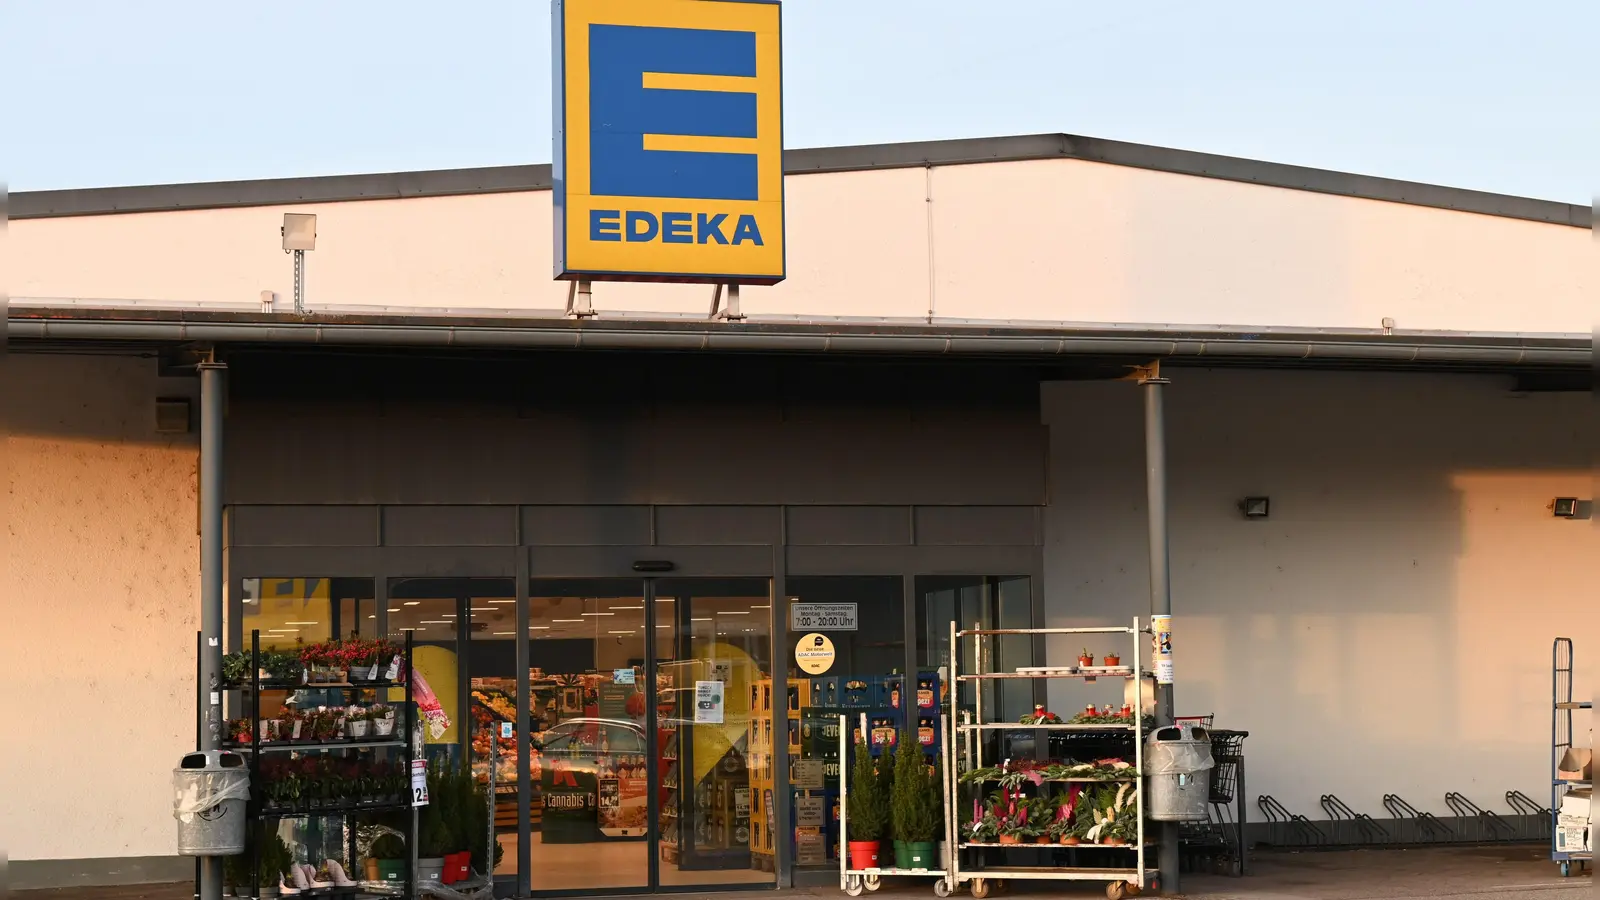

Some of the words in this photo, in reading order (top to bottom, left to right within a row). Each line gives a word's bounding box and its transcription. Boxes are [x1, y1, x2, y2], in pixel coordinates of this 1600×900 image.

[588, 23, 758, 201] E
[589, 209, 764, 246] EDEKA
[796, 617, 811, 626] 7:00
[818, 617, 837, 626] 20:00
[840, 617, 853, 626] Uhr
[822, 724, 840, 737] JEVE
[823, 763, 840, 776] JEVE
[547, 792, 584, 807] Cannabis
